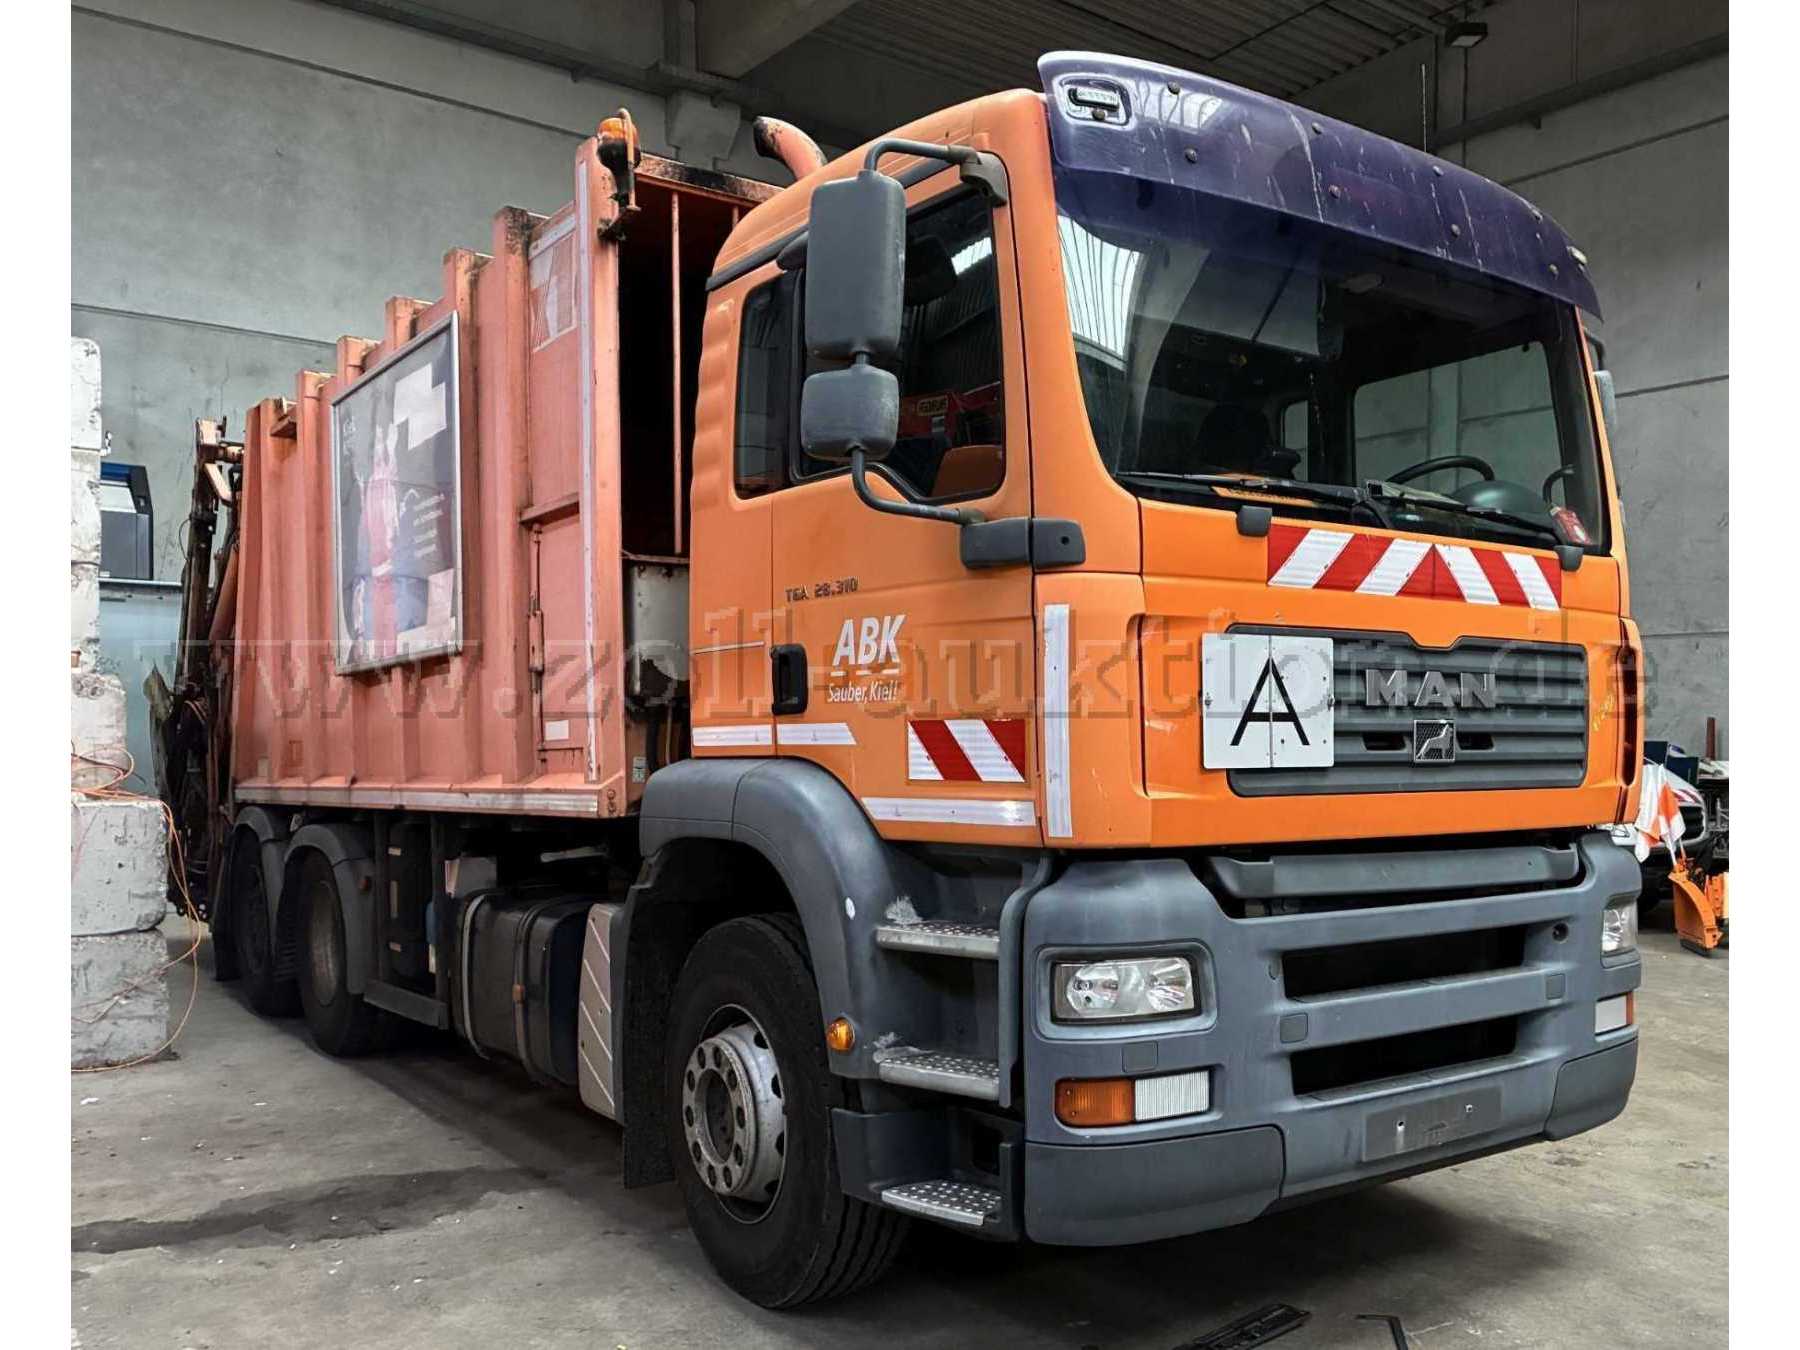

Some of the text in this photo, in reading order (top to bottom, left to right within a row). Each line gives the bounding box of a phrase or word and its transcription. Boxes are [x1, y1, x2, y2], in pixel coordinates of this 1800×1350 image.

[831, 613, 907, 667] ABK
[1230, 656, 1311, 746] A
[1365, 668, 1497, 708] MAN
